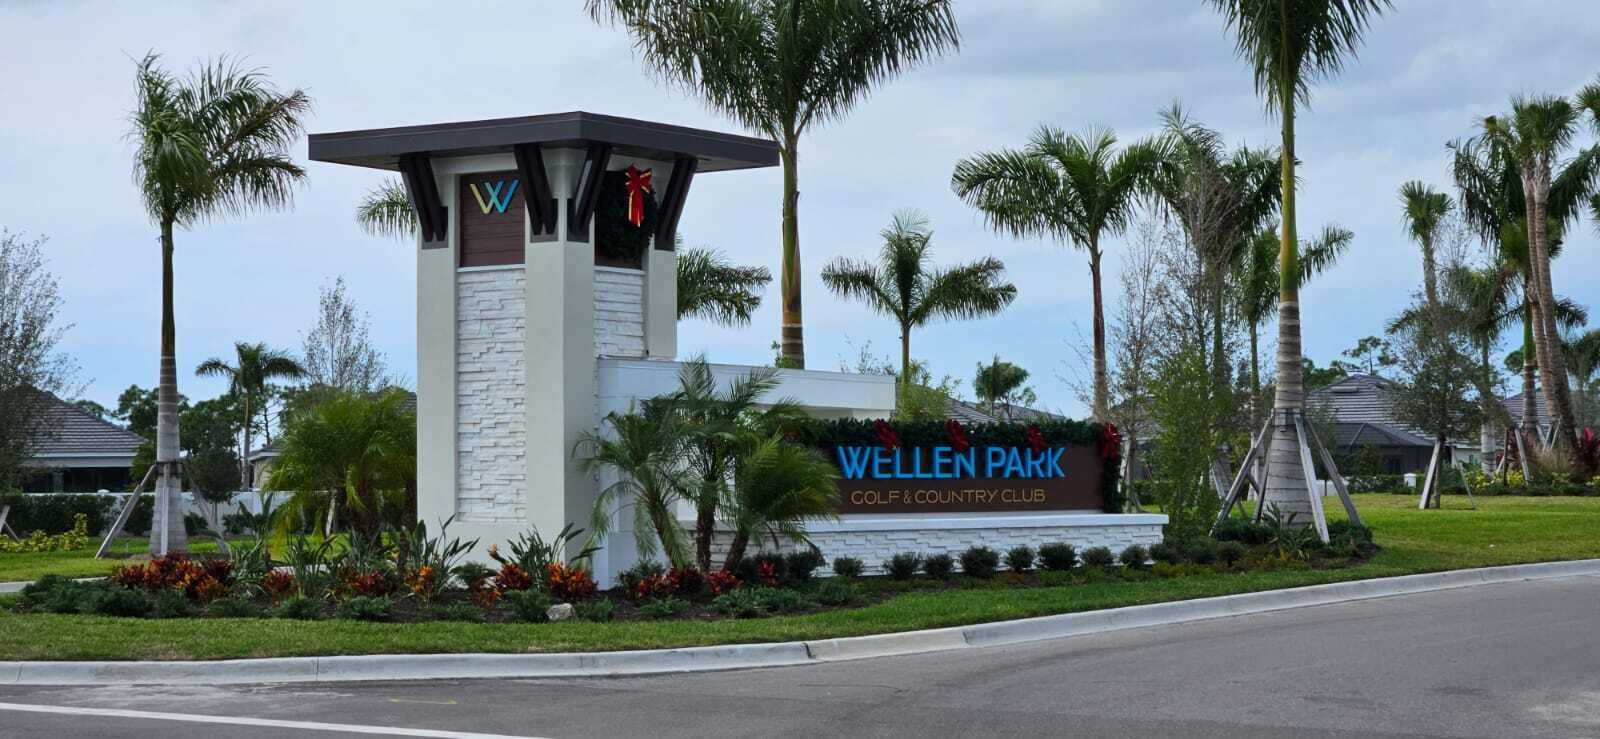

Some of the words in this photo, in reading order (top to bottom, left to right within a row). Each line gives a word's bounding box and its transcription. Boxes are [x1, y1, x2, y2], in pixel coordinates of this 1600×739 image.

[837, 446, 976, 479] WELLEN
[984, 447, 1066, 478] PARK
[851, 490, 900, 505] GOLF
[903, 491, 912, 504] &
[914, 488, 999, 504] COUNTRY
[1000, 488, 1046, 503] CLUB
